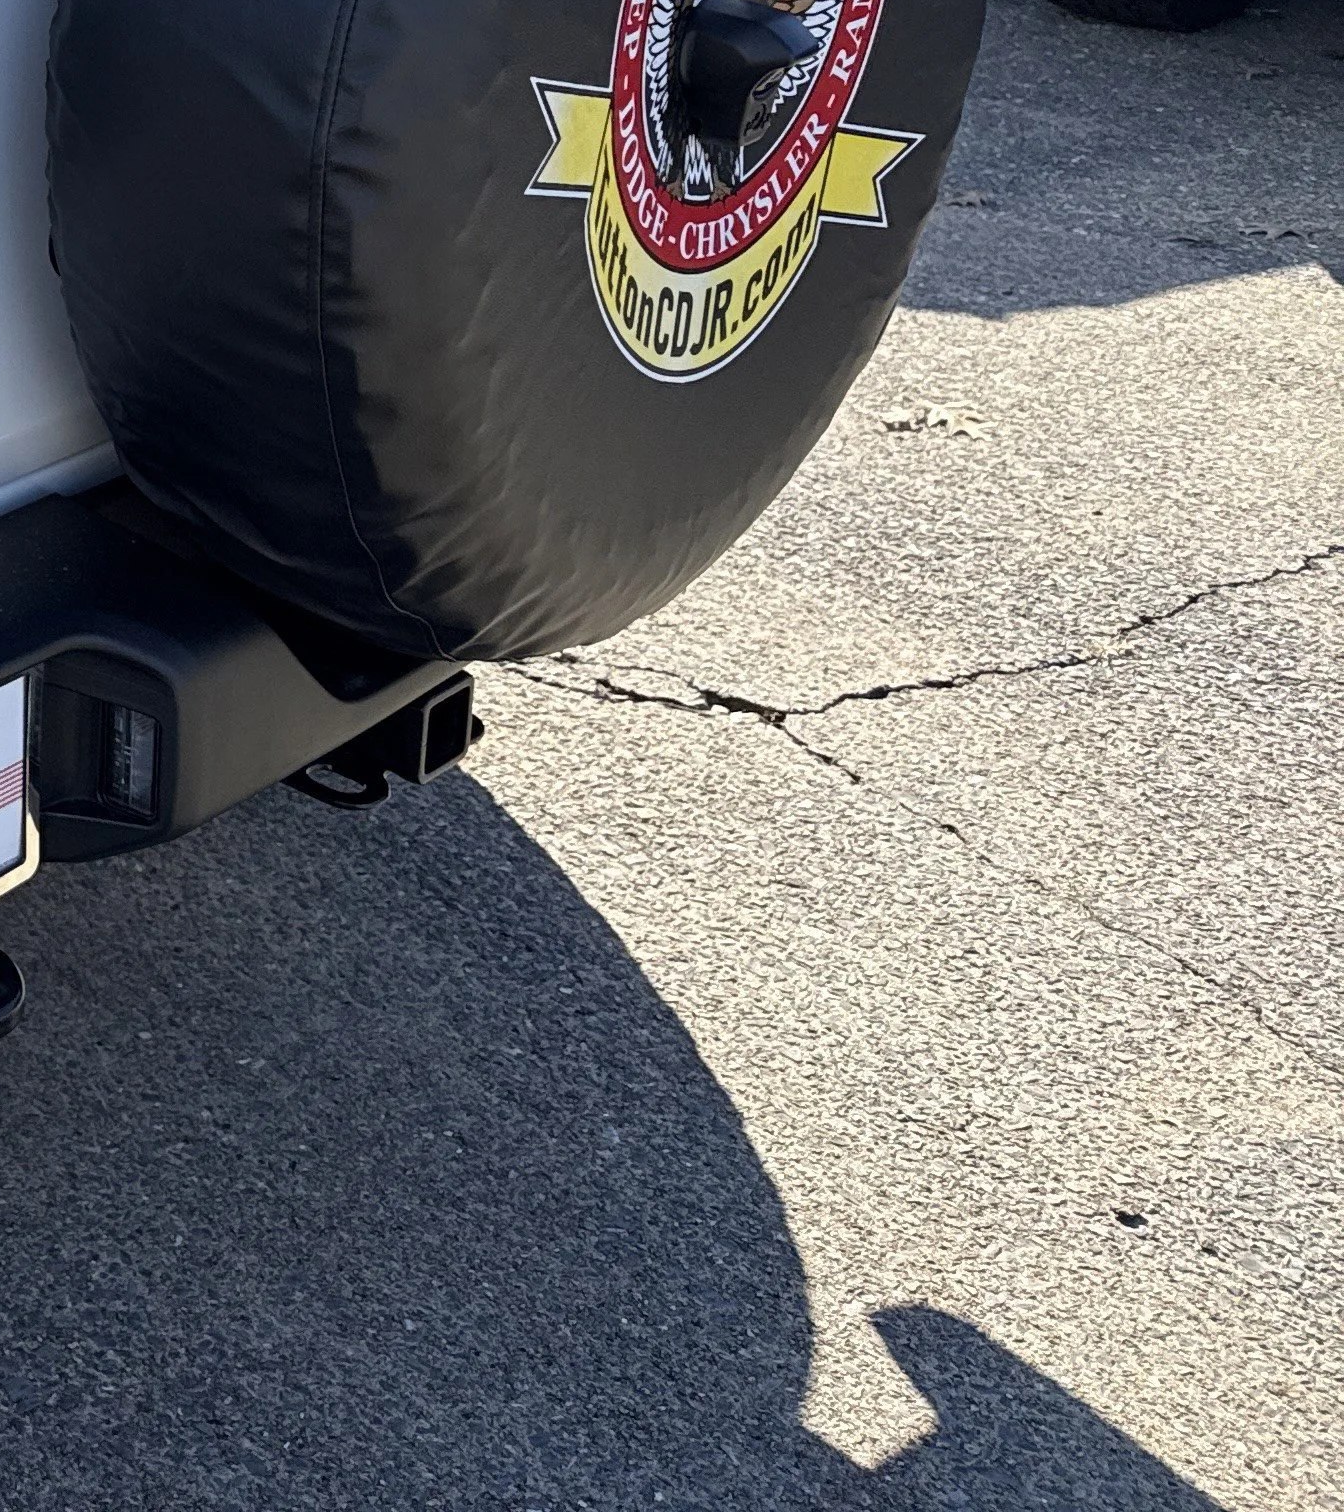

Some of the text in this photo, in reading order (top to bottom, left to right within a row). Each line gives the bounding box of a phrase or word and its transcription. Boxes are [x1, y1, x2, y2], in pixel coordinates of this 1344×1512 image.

[595, 143, 816, 358] TuttonCDJR.com
[619, 92, 669, 247] DODGE
[679, 112, 829, 260] CHRYSLER
